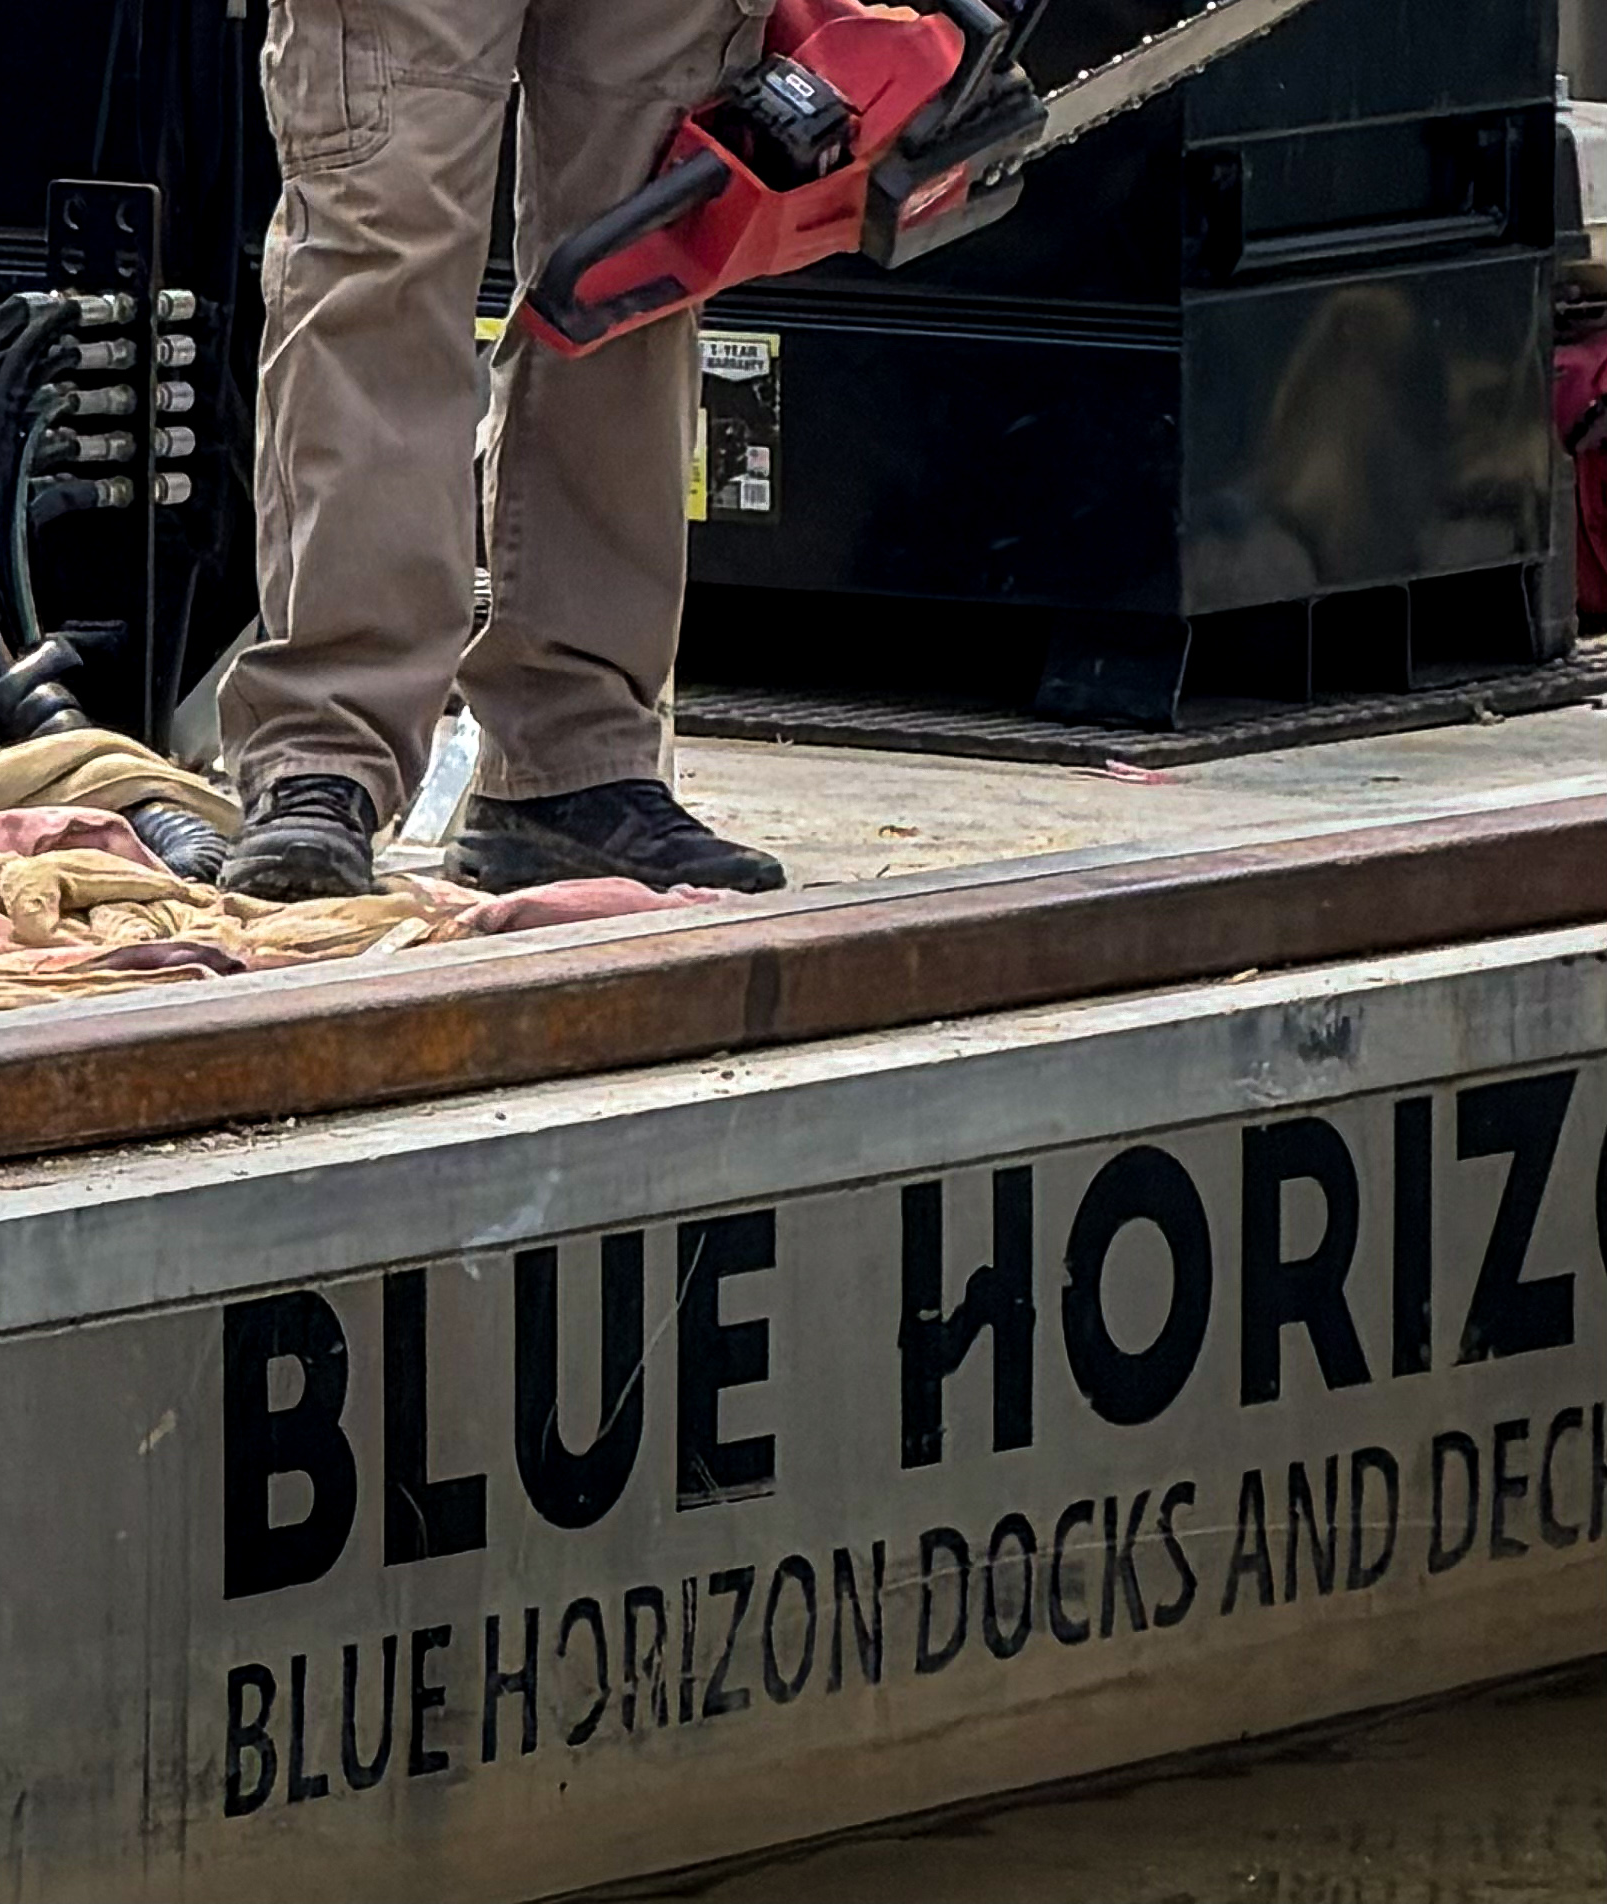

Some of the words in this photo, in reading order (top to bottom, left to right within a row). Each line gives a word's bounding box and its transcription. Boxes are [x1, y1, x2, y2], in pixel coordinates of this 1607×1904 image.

[223, 1207, 777, 1600] BLUE
[898, 1068, 1607, 1470] HORIZ
[223, 1623, 452, 1819] BLUE
[481, 1539, 887, 1766] HORIZON
[914, 1480, 1199, 1677] DOCKS
[1219, 1444, 1400, 1617] AND
